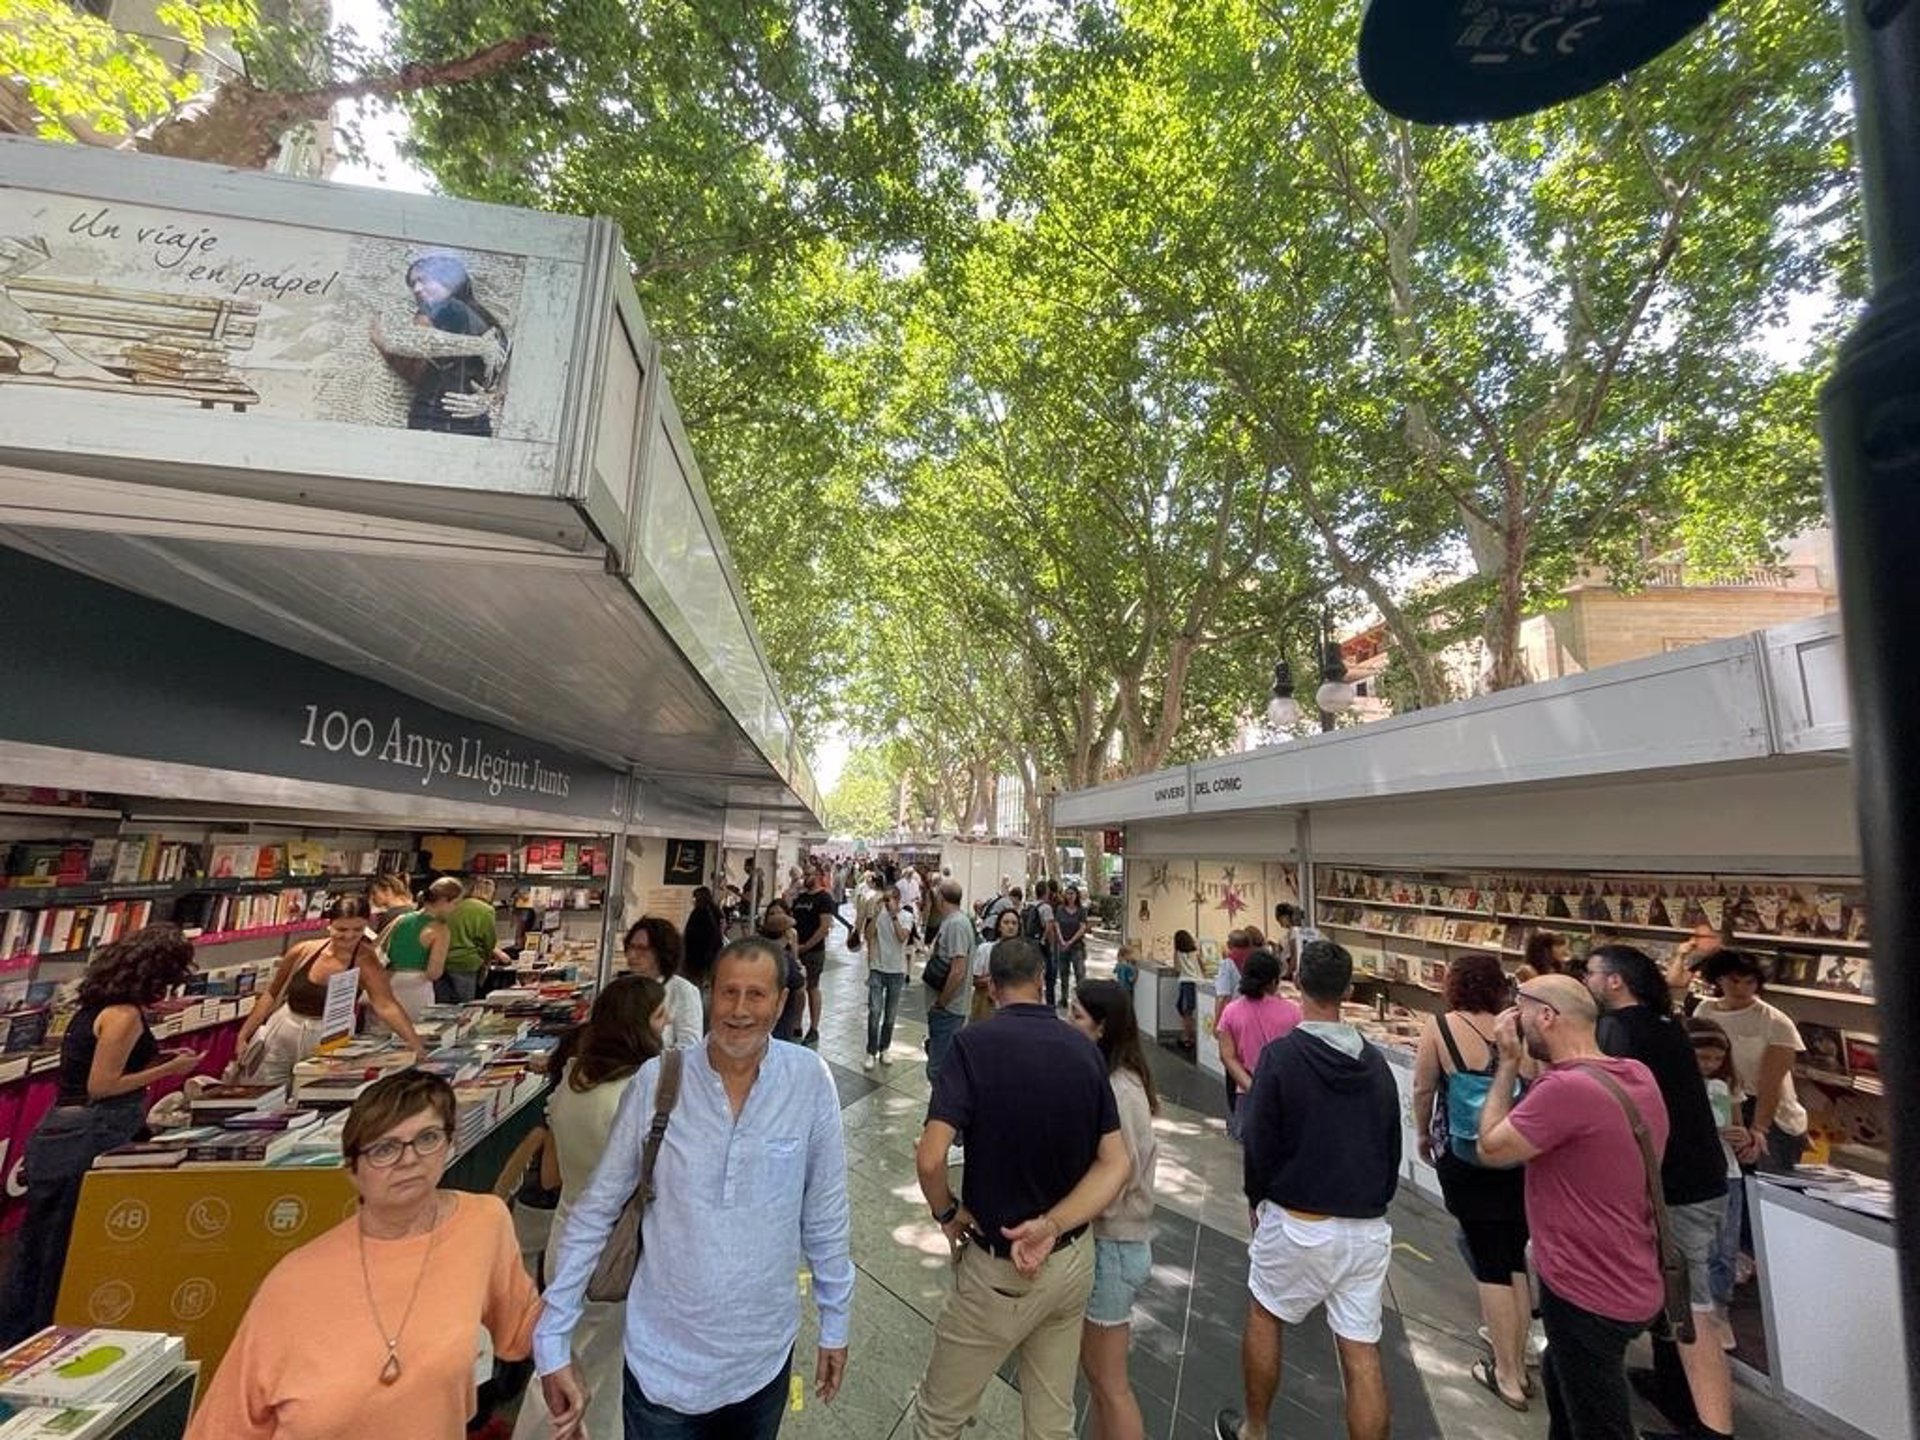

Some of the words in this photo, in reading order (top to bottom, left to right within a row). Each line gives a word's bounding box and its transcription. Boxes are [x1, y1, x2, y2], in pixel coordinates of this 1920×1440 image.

[68, 208, 121, 239] Un
[137, 225, 219, 269] viaje
[188, 264, 226, 284] en
[233, 271, 340, 299] papel
[300, 704, 374, 757] 100
[378, 717, 453, 787] Anys
[456, 736, 529, 797] Llegint
[529, 758, 571, 798] Junts
[1154, 785, 1186, 802] UNIVERS
[1195, 781, 1211, 795] DEL
[110, 1208, 143, 1230] 48
